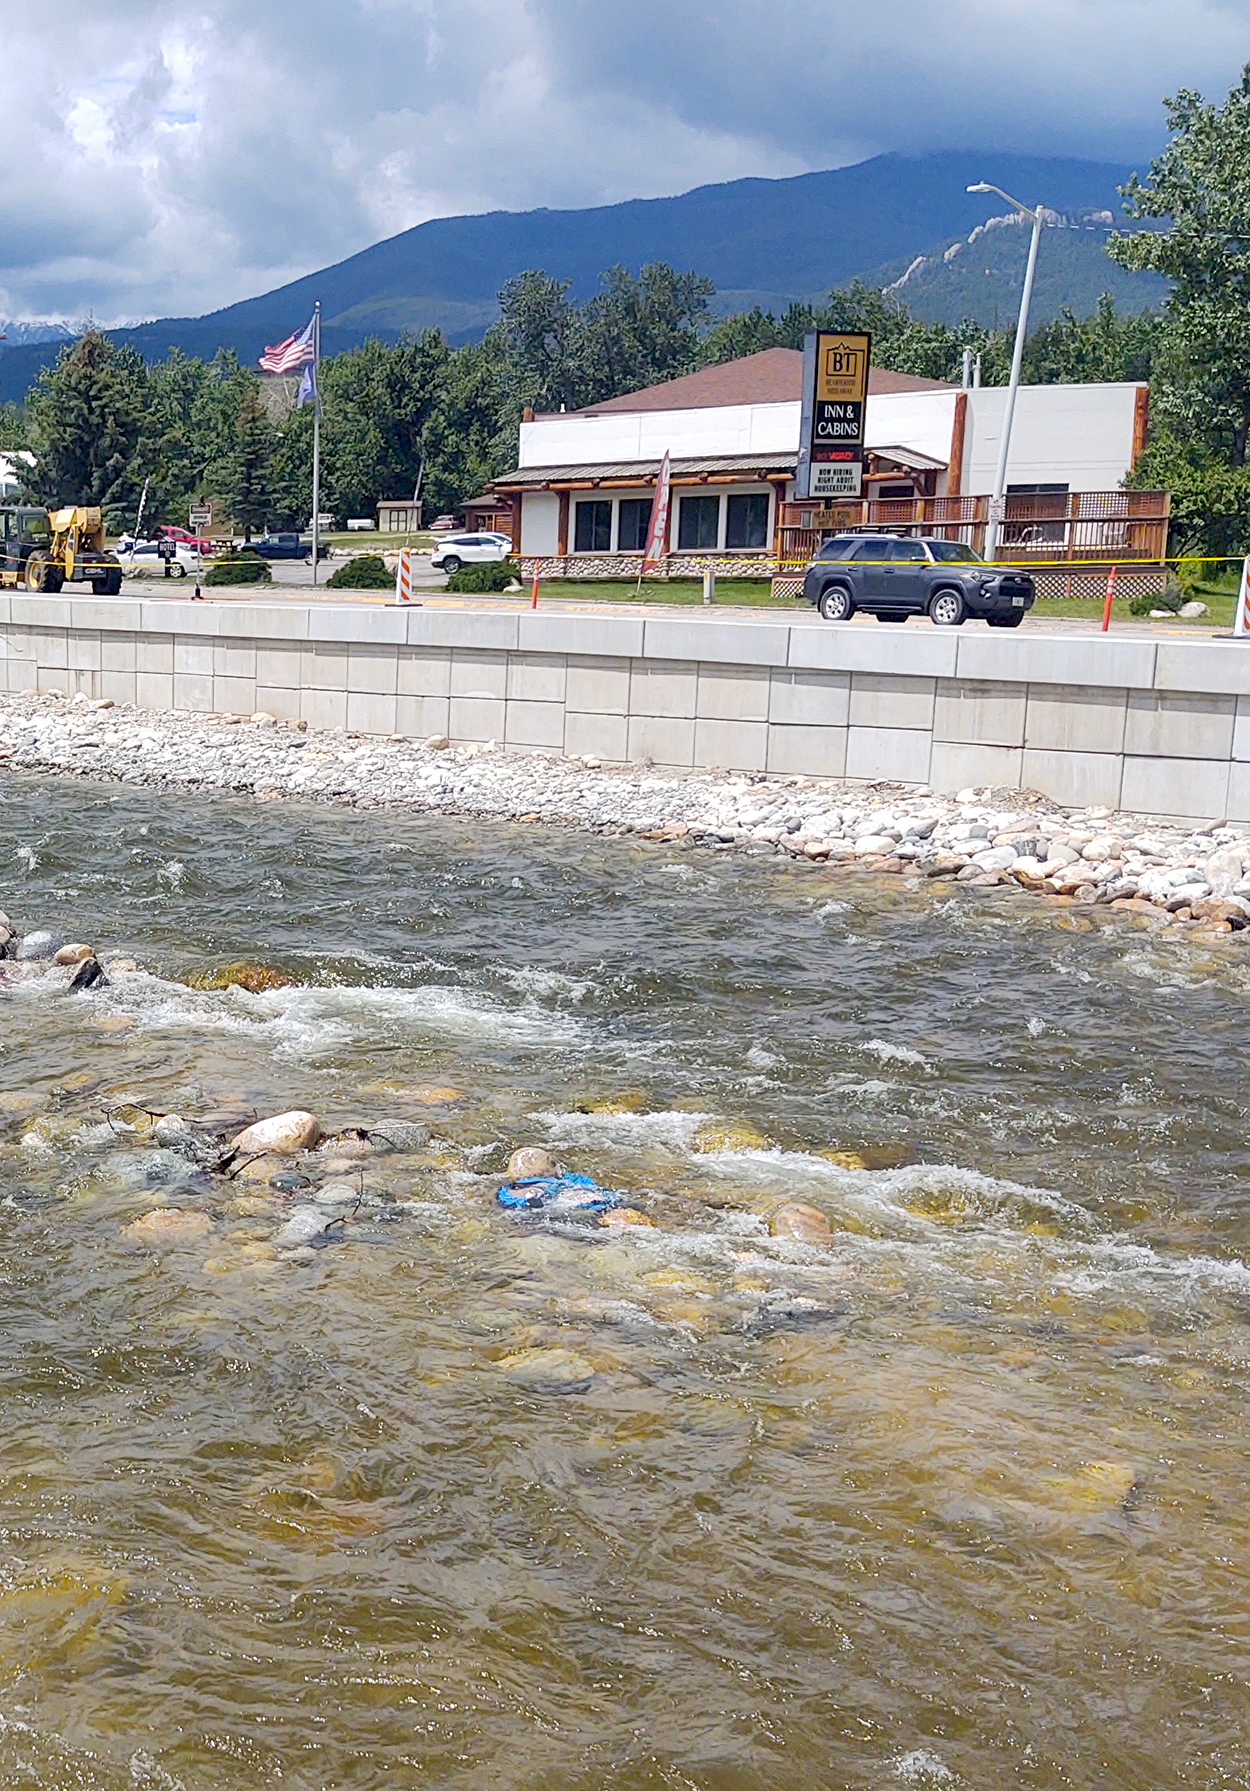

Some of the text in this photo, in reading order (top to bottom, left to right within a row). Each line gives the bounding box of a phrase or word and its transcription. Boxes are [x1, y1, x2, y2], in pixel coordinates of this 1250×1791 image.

[833, 352, 856, 372] BT
[824, 405, 855, 419] INN &
[818, 422, 859, 435] CABINS
[819, 468, 853, 476] NOW HIRING
[814, 484, 857, 492] HOUSEKEEPING
